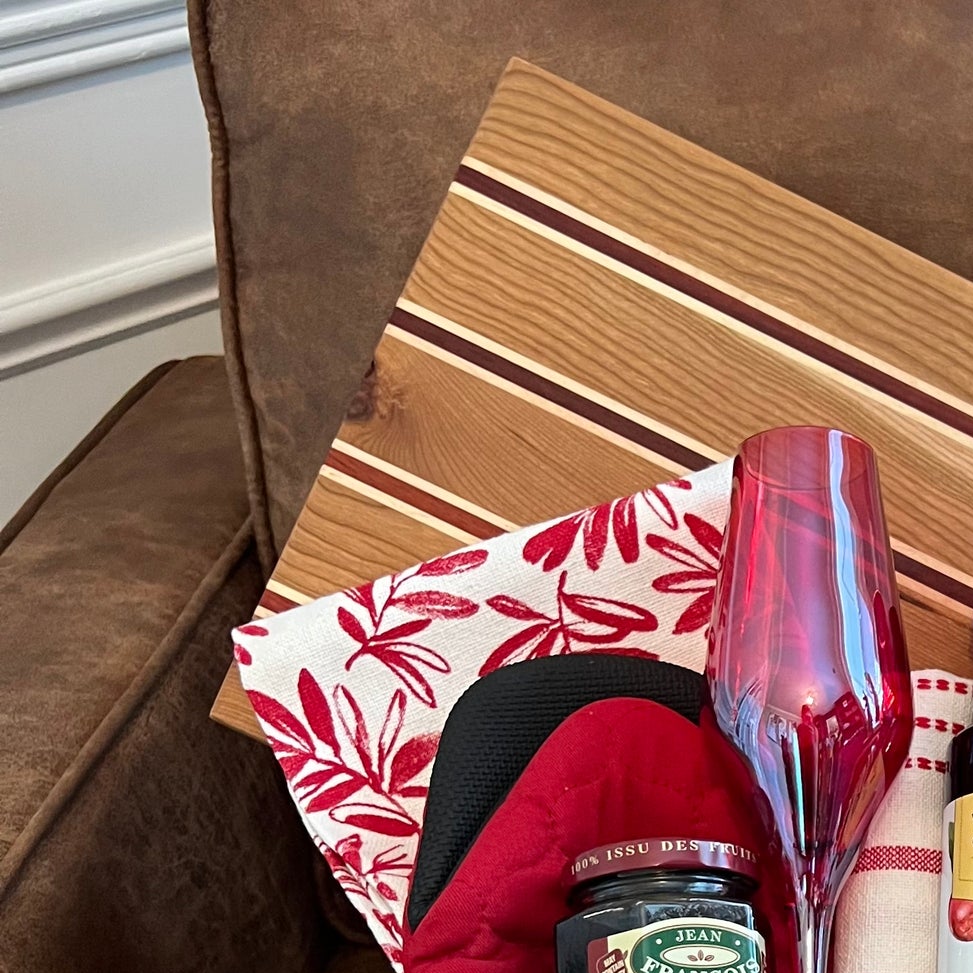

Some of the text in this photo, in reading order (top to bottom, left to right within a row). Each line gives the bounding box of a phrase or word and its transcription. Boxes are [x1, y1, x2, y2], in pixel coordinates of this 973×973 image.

[571, 856, 600, 876] 100%
[606, 842, 650, 861] ISSU
[661, 840, 699, 851] DES
[675, 930, 723, 943] JEAN
